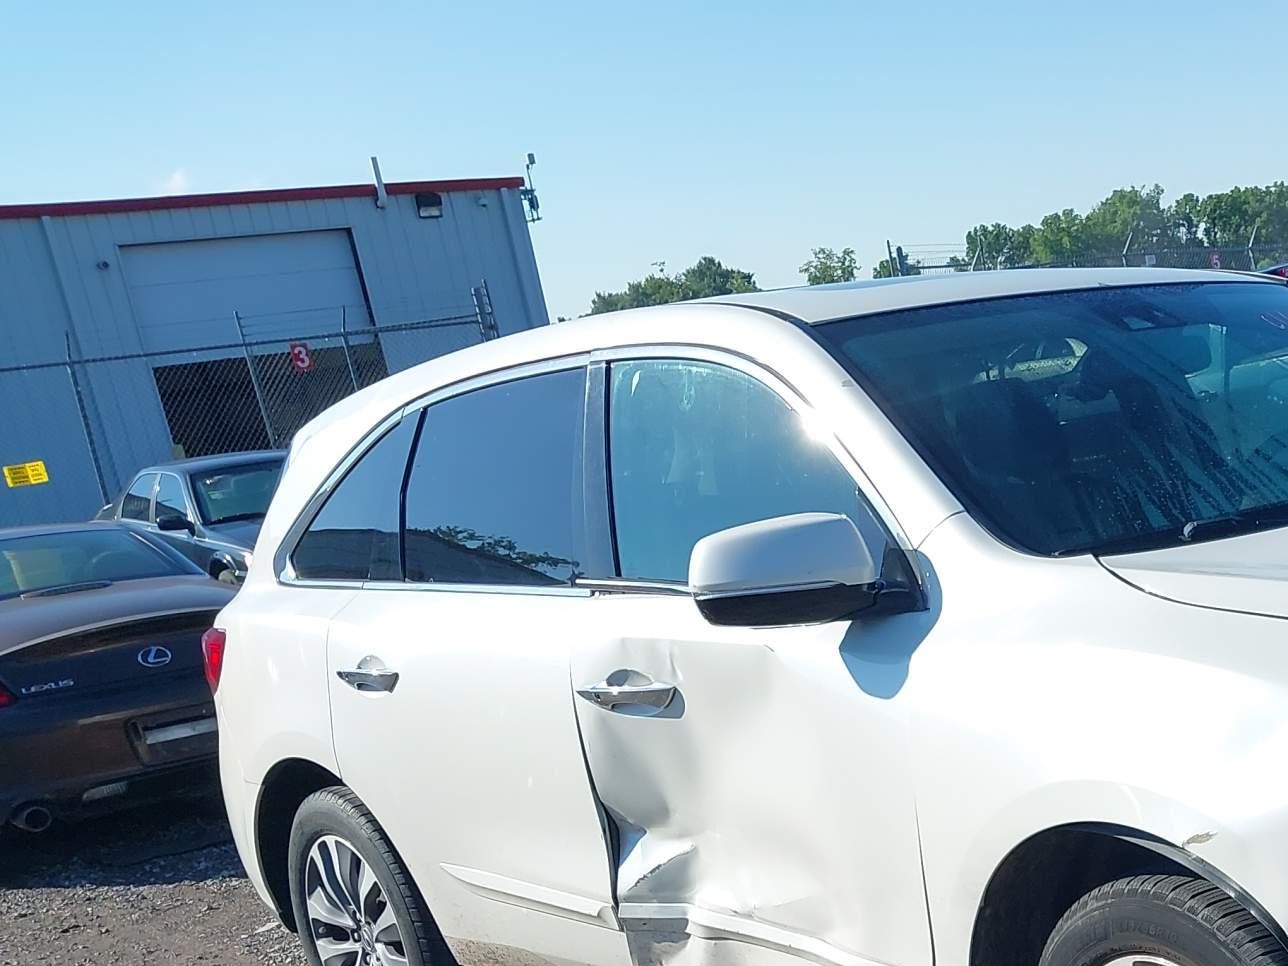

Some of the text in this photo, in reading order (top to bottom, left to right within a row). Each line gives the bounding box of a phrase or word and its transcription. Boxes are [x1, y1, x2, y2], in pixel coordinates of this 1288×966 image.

[1212, 254, 1221, 270] 5
[294, 346, 310, 368] 3
[21, 679, 74, 694] LEXUS
